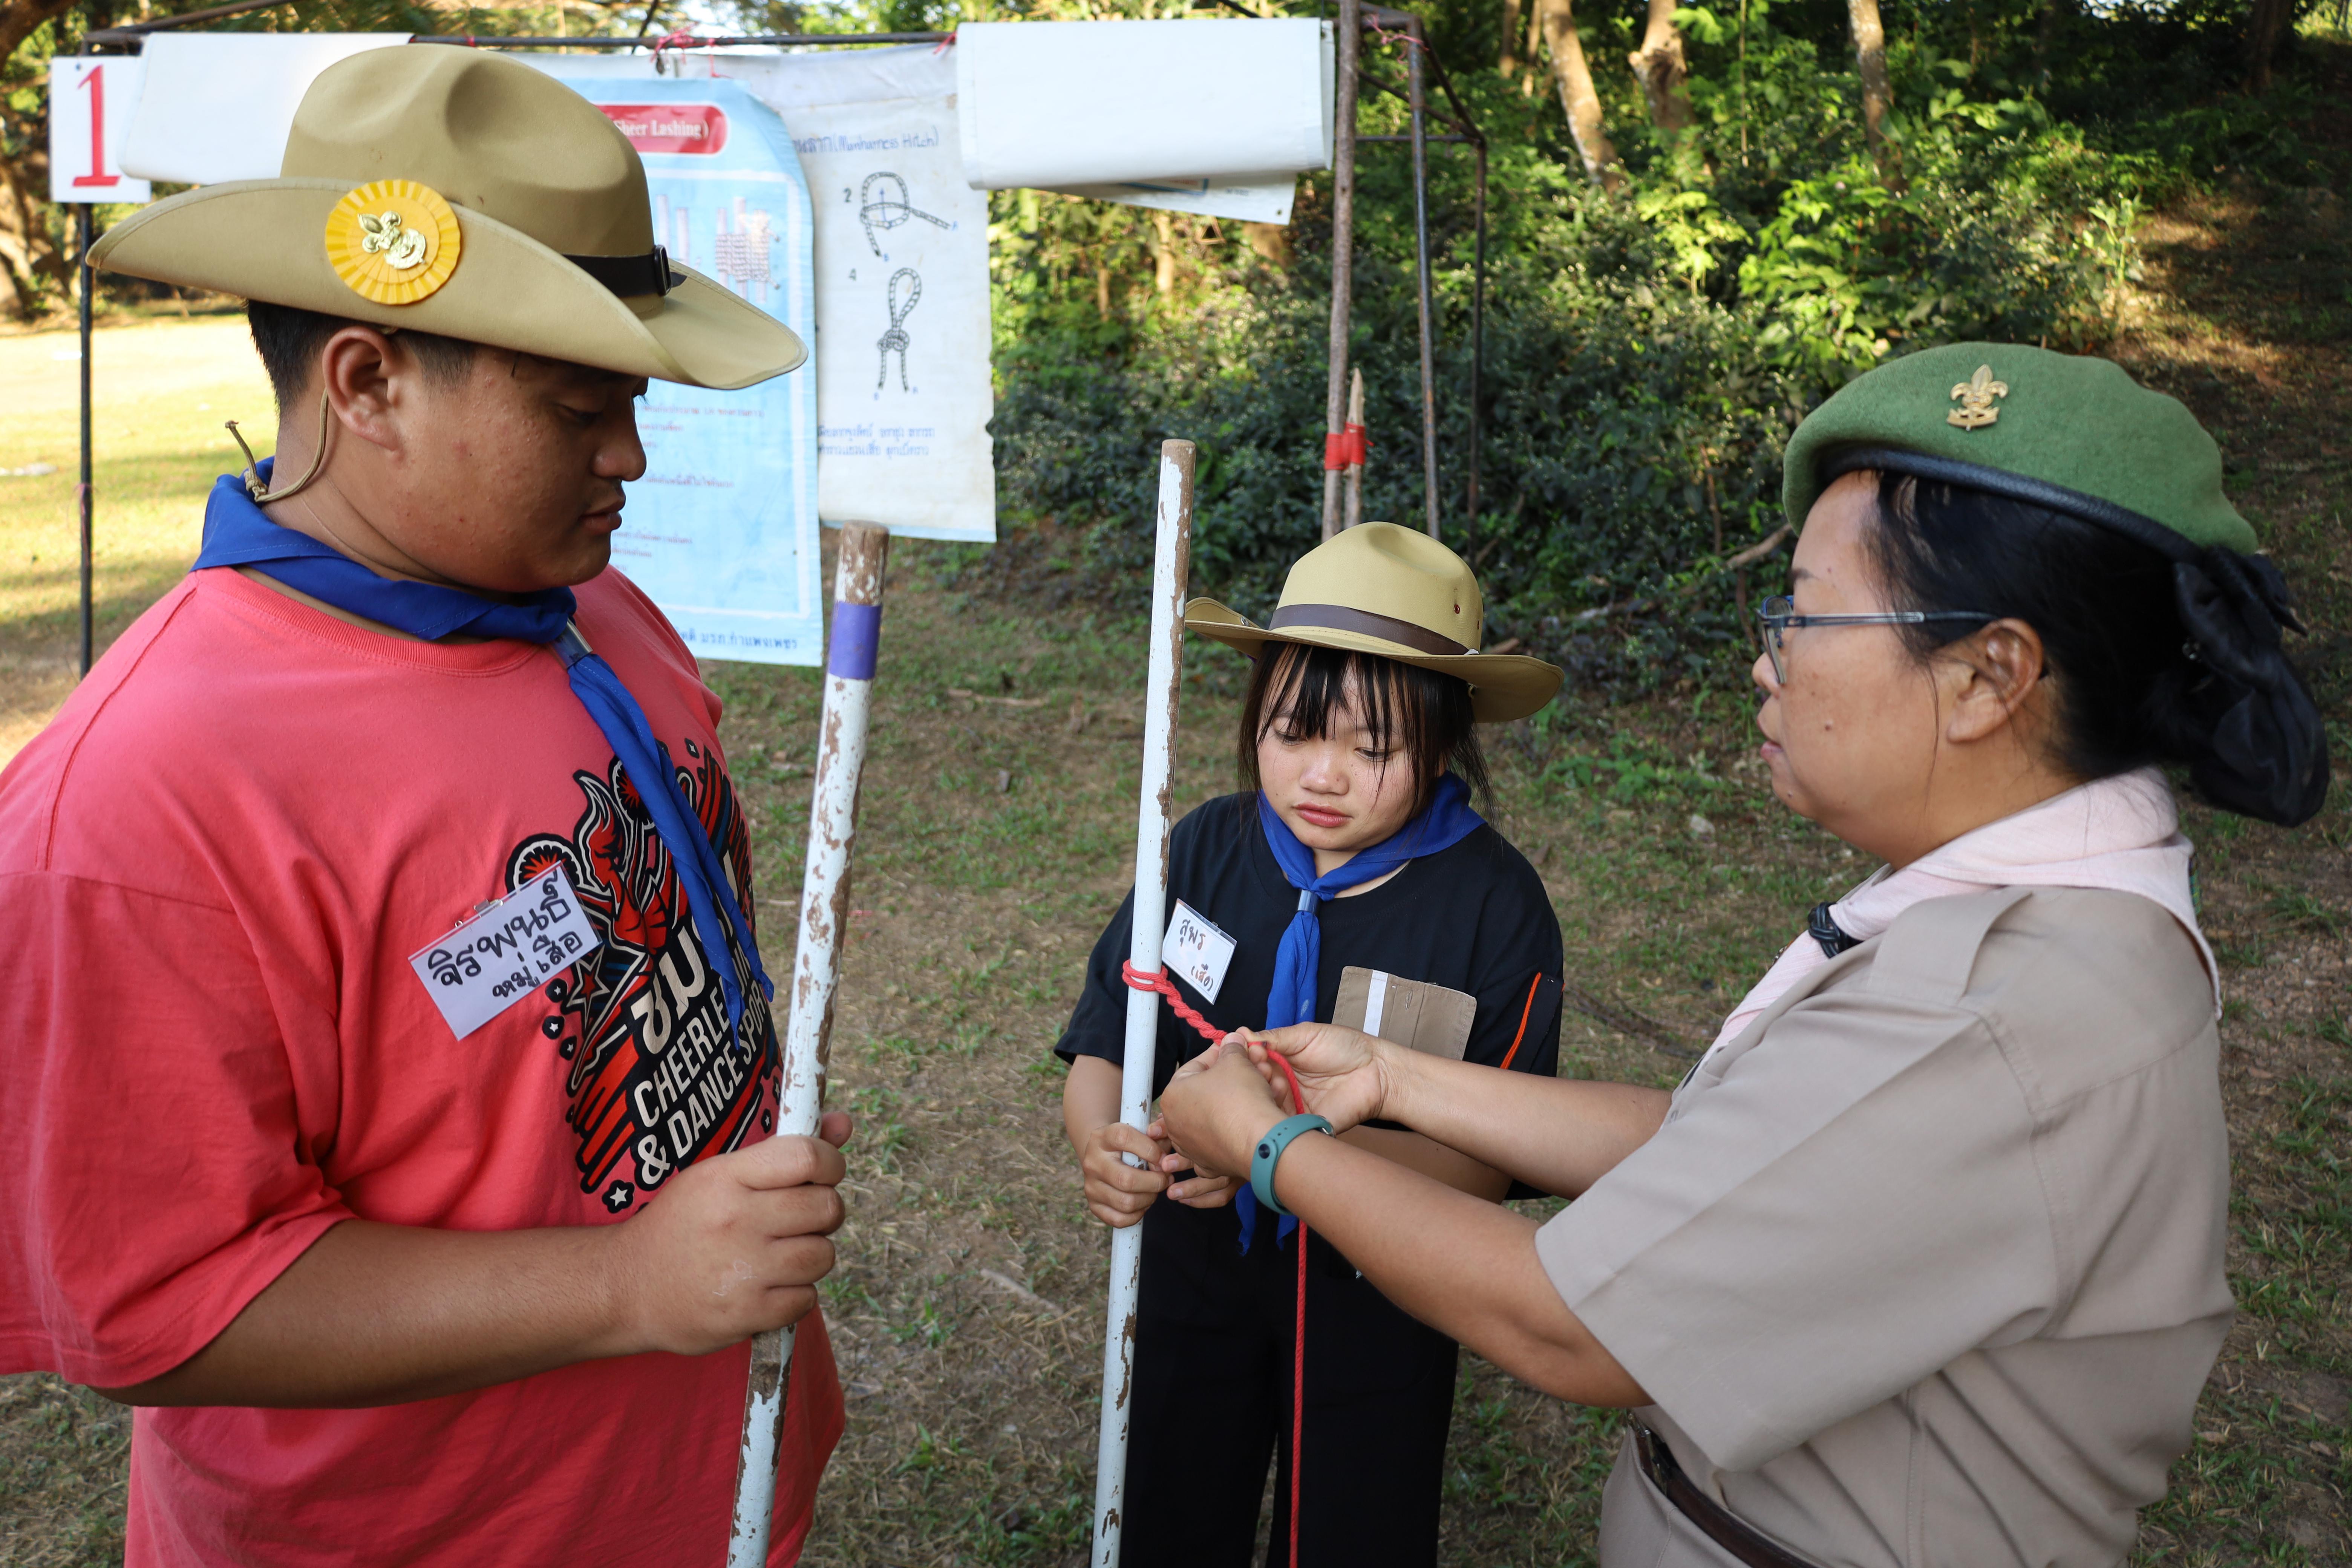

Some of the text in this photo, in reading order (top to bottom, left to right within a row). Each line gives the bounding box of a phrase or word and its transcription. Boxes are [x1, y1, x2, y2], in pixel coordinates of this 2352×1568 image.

[72, 64, 122, 187] 1
[844, 187, 851, 203] 2
[637, 1134, 671, 1185] &
[667, 1040, 744, 1159] DANCE
